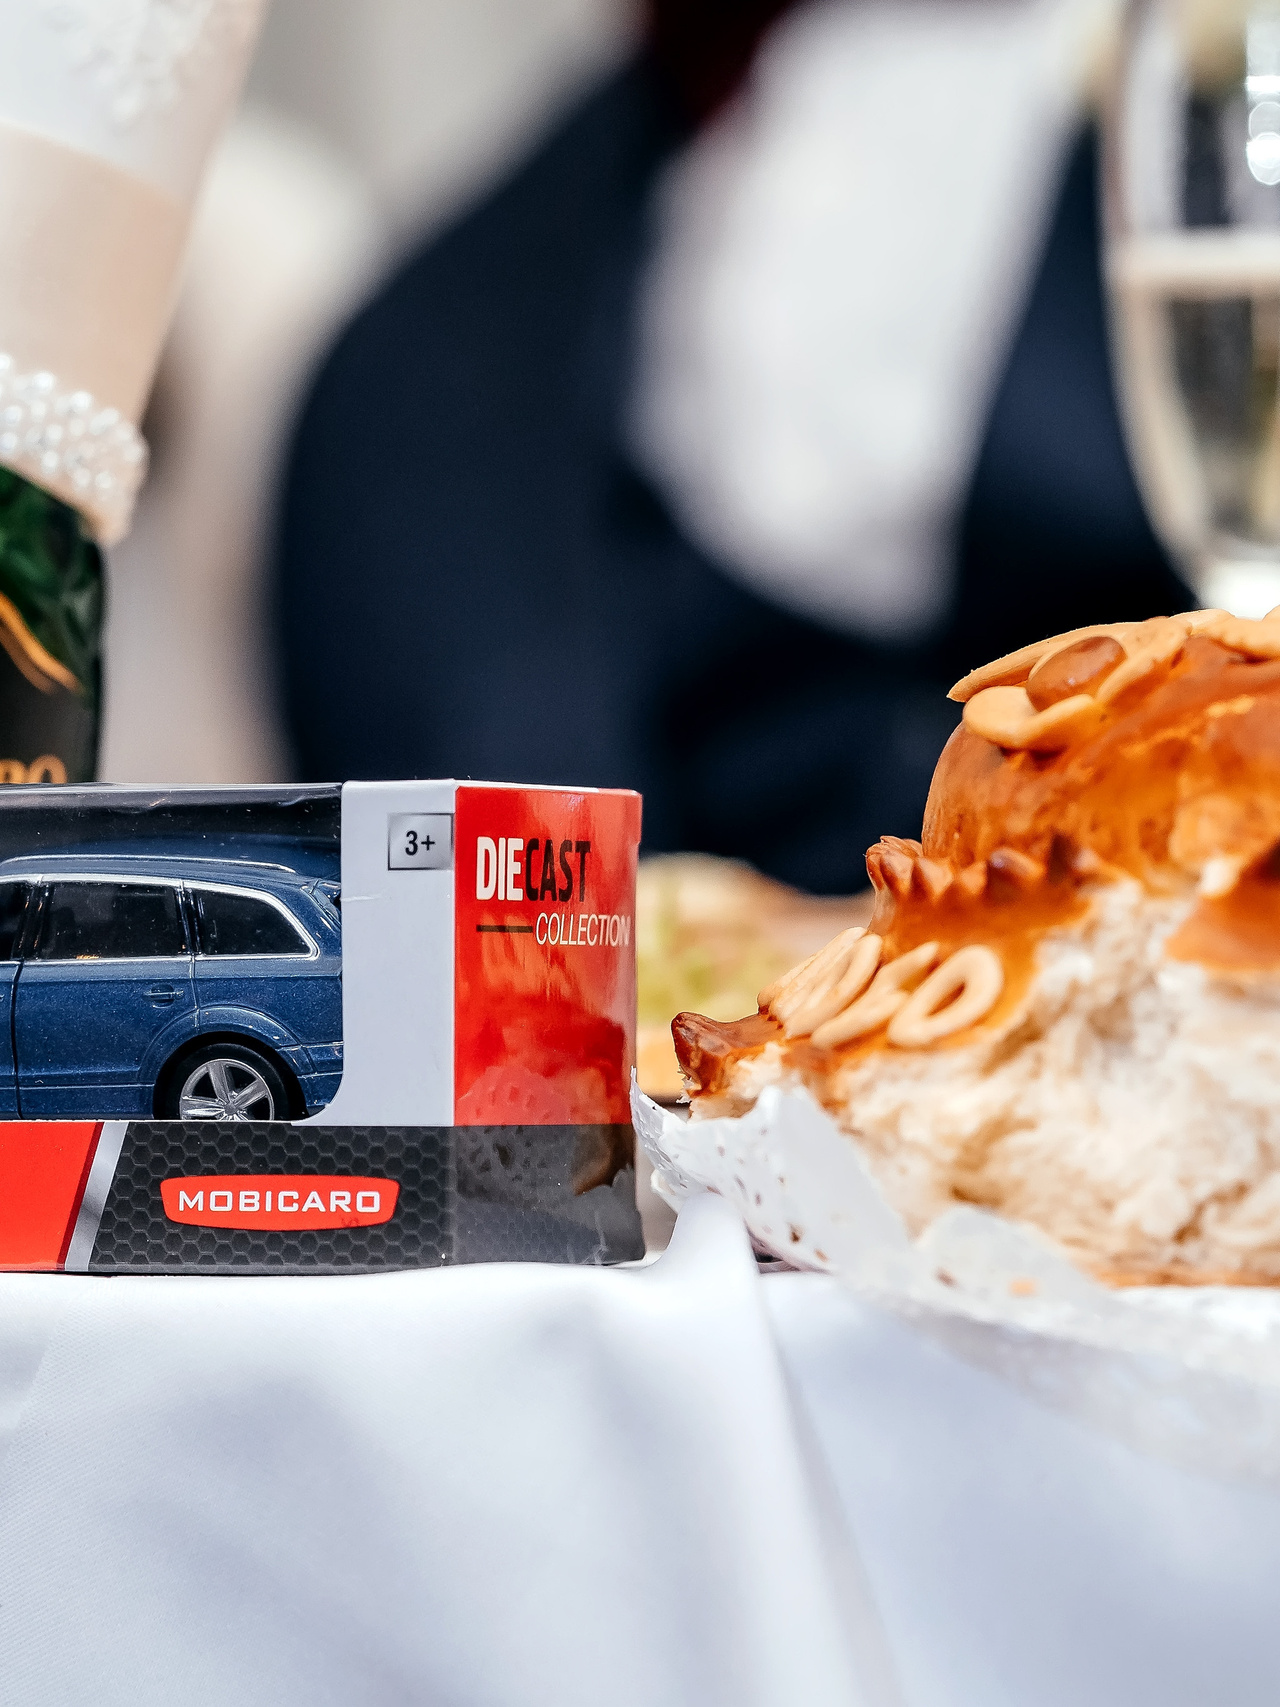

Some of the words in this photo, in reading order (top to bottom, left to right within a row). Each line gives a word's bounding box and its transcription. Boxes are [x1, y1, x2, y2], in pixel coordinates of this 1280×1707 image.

[404, 830, 436, 856] 3+
[476, 836, 591, 902] DIECAST
[535, 912, 631, 947] COLLECTION
[178, 1190, 381, 1213] MOBICARO
